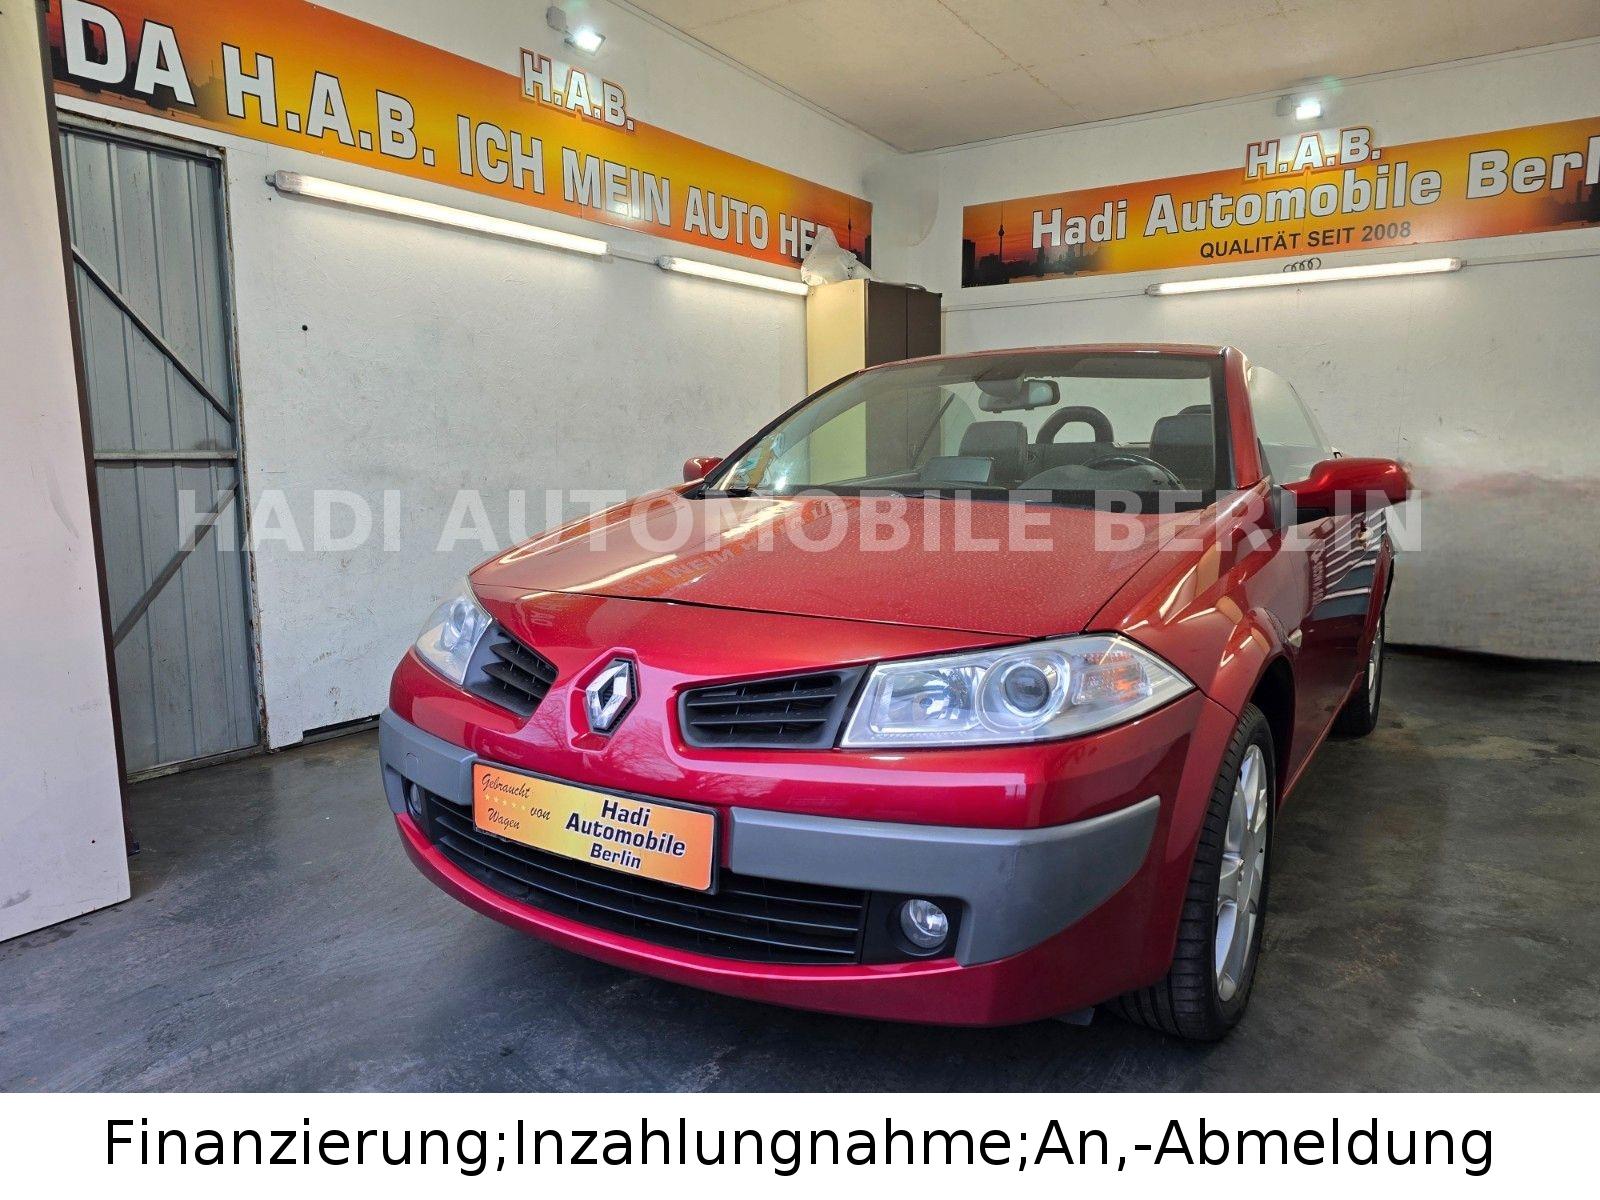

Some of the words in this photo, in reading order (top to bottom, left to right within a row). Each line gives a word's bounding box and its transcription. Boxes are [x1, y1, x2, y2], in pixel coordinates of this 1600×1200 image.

[520, 50, 635, 132] H.A.B.
[62, 0, 195, 107] DA
[221, 42, 436, 167] H.A.B.
[456, 114, 545, 194] ICH
[561, 147, 671, 227] MEIN
[683, 185, 769, 250] AUTO
[779, 212, 830, 260] HE
[1246, 127, 1382, 179] H.A.B.
[1032, 199, 1128, 249] Hadi
[1143, 161, 1441, 237] Automobile
[1200, 233, 1302, 259] QUALITÄT
[1307, 227, 1353, 248] SEIT
[1361, 221, 1412, 242] 2008
[481, 773, 531, 799] Gebraucht
[487, 807, 521, 831] Wagen
[530, 807, 551, 821] von
[601, 799, 652, 828] Hadi
[565, 812, 686, 857] Automobile
[590, 842, 642, 869] Berlin
